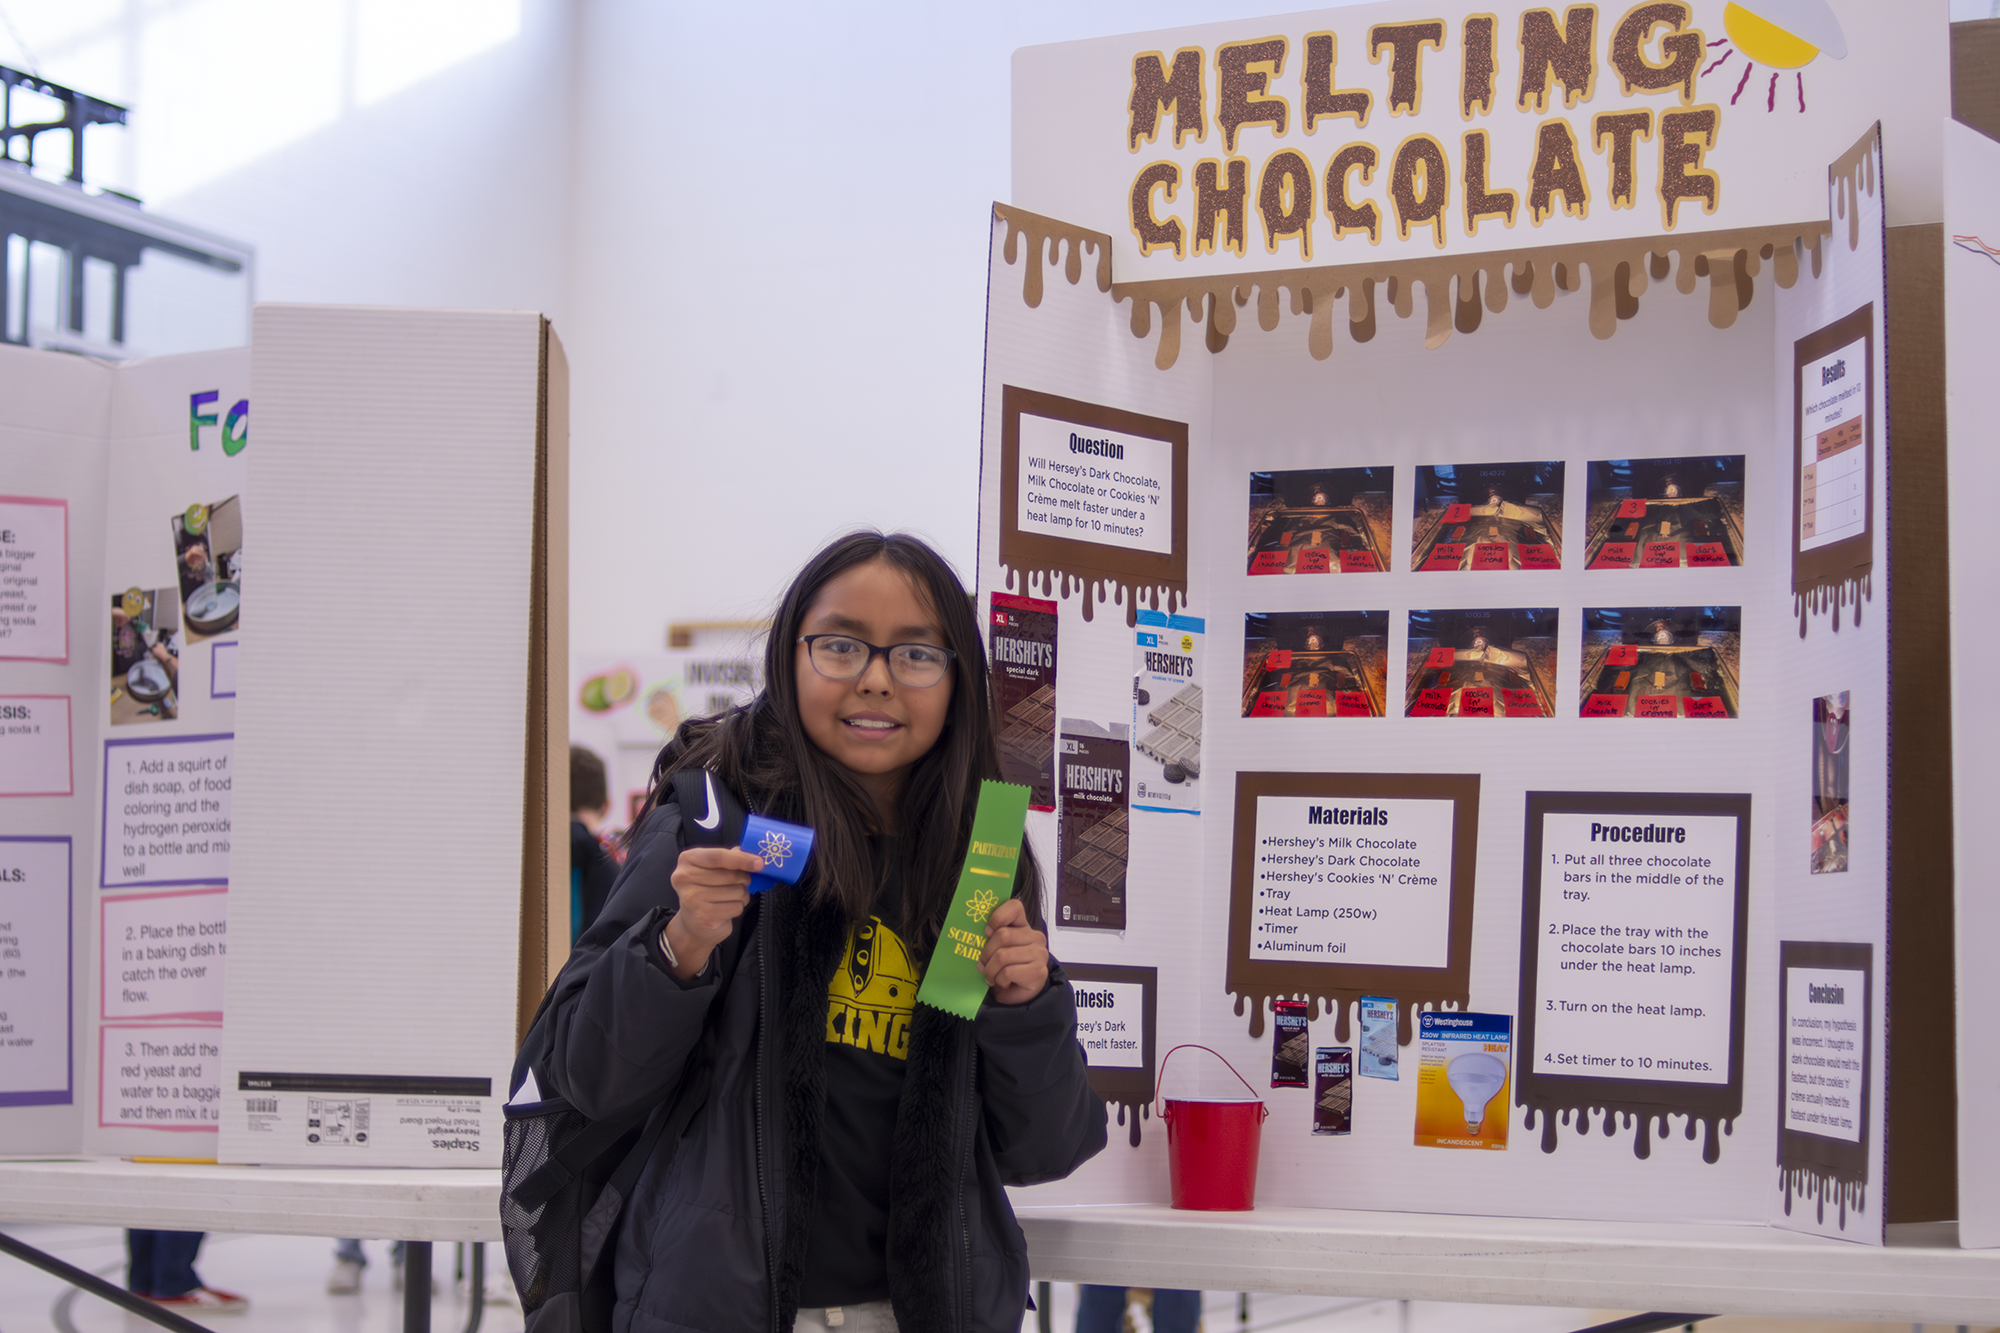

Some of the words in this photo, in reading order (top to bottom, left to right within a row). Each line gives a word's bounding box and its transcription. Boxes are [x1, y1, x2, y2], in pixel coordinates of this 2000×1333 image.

[1128, 1, 1707, 152] MELTING
[1129, 104, 1720, 259] CHOCOLATE
[1822, 359, 1846, 387] Results
[1070, 432, 1124, 460] Question
[1028, 456, 1045, 469] Will
[1049, 460, 1086, 477] Hersey's
[1090, 468, 1110, 481] Dark
[1113, 472, 1160, 490] Chocolate,
[1028, 474, 1046, 487] Milk
[1049, 478, 1094, 495] Chocolate
[1098, 488, 1107, 497] or
[1110, 488, 1145, 503] Cookies
[1028, 492, 1057, 506] Crème
[1060, 498, 1080, 510] melt
[1083, 501, 1108, 515] faster
[1111, 508, 1137, 520] under
[1140, 512, 1145, 520] a
[1454, 507, 1459, 518] 2
[1629, 502, 1637, 513] 3
[1027, 510, 1047, 522] heat
[1050, 513, 1072, 528] lamp
[1075, 517, 1088, 529] for
[1091, 520, 1100, 530] 10
[1104, 523, 1143, 537] minutes?
[996, 614, 1004, 623] XL
[1146, 636, 1154, 644] XL
[996, 636, 1052, 668] HERSHEY'S
[1437, 651, 1443, 663] 2
[1618, 648, 1626, 658] 3
[1006, 666, 1025, 674] special
[1026, 668, 1039, 676] dark
[1146, 652, 1193, 677] HERSHEY'S
[1465, 691, 1489, 699] cookies
[1067, 743, 1074, 751] XL
[126, 761, 135, 775] 1.
[139, 760, 163, 774] Add
[167, 761, 174, 773] a
[178, 757, 211, 774] squirt
[215, 755, 227, 770] of
[124, 781, 149, 795] dish
[152, 781, 184, 795] soap,
[189, 778, 201, 792] of
[204, 776, 231, 792] food
[1067, 764, 1122, 793] HERSHEY'S
[1086, 793, 1112, 802] chocolate
[124, 800, 171, 818] coloring
[175, 799, 197, 813] and
[201, 798, 219, 812] the
[1309, 806, 1388, 826] Materials
[123, 822, 178, 839] hydrogen
[1591, 823, 1686, 843] Procedure
[1268, 836, 1324, 848] Hershey's
[1329, 837, 1352, 848] Milk
[1356, 838, 1417, 850] Chocolate
[972, 841, 1017, 860] PARTICIPANT
[1267, 853, 1324, 866] Hershey's
[1328, 855, 1355, 866] Dark
[1359, 856, 1420, 867] Chocolate
[1551, 854, 1559, 865] 1.
[1564, 854, 1586, 865] Put
[1590, 855, 1604, 865] all
[1609, 855, 1643, 866] three
[1647, 856, 1711, 868] chocolate
[1266, 871, 1323, 884] Hershey's
[1327, 872, 1375, 884] Cookies
[1398, 875, 1437, 885] Crème
[1564, 871, 1591, 883] bars
[1595, 872, 1607, 884] in
[1611, 872, 1632, 884] the
[1636, 873, 1681, 885] middle
[1685, 874, 1699, 885] of
[1703, 875, 1724, 886] the
[1266, 888, 1290, 900] Tray
[1563, 890, 1590, 902] tray.
[1265, 906, 1292, 916] Heat
[1296, 907, 1329, 919] Lamp
[1333, 908, 1377, 920] (250w)
[126, 926, 137, 941] 2.
[140, 925, 173, 939] Place
[177, 923, 195, 937] the
[1264, 923, 1298, 934] Timer
[1548, 924, 1559, 935] 2.
[1562, 924, 1596, 936] Place
[1600, 925, 1621, 936] the
[1625, 926, 1650, 939] tray
[1655, 927, 1683, 938] with
[1687, 928, 1709, 939] the
[954, 943, 981, 961] FAIR
[1263, 941, 1323, 952] Aluminum
[1327, 942, 1346, 953] foil
[1561, 942, 1624, 955] chocolate
[1628, 943, 1656, 956] bars
[1661, 945, 1675, 956] 10
[1679, 945, 1721, 957] inches
[122, 968, 155, 982] catch
[158, 966, 178, 980] the
[181, 965, 207, 979] over
[1560, 959, 1598, 970] under
[1602, 961, 1623, 972] the
[1627, 962, 1656, 973] heat
[1660, 962, 1696, 976] lamp.
[1809, 982, 1844, 1005] Conclusion
[1367, 1009, 1393, 1020] HERSHEY'S
[1546, 1000, 1557, 1011] 3.
[1559, 1000, 1587, 1012] Turn
[1591, 1003, 1608, 1013] on
[1611, 1002, 1633, 1014] the
[1637, 1003, 1666, 1015] heat
[1670, 1004, 1706, 1018] lamp.
[1105, 1021, 1126, 1031] Dark
[1276, 1015, 1306, 1027] HERSHEY'S
[1434, 1018, 1473, 1027] Westinghouse
[1087, 1038, 1107, 1049] melt
[1110, 1038, 1137, 1049] faster.
[1483, 1044, 1508, 1052] HEAT
[1317, 1063, 1349, 1073] HERSHEY'S
[1544, 1052, 1556, 1064] 4.
[1557, 1054, 1578, 1065] Set
[1582, 1055, 1616, 1067] timer
[1621, 1056, 1634, 1067] to
[1638, 1057, 1652, 1068] 10
[1657, 1058, 1712, 1071] minutes.
[121, 1064, 140, 1078] red
[143, 1064, 175, 1080] yeast
[179, 1063, 201, 1078] and
[425, 1117, 452, 1126] Project
[428, 1127, 480, 1136] Heavyweight
[432, 1138, 479, 1152] Staples
[1436, 1138, 1483, 1147] INCANDESCENT
